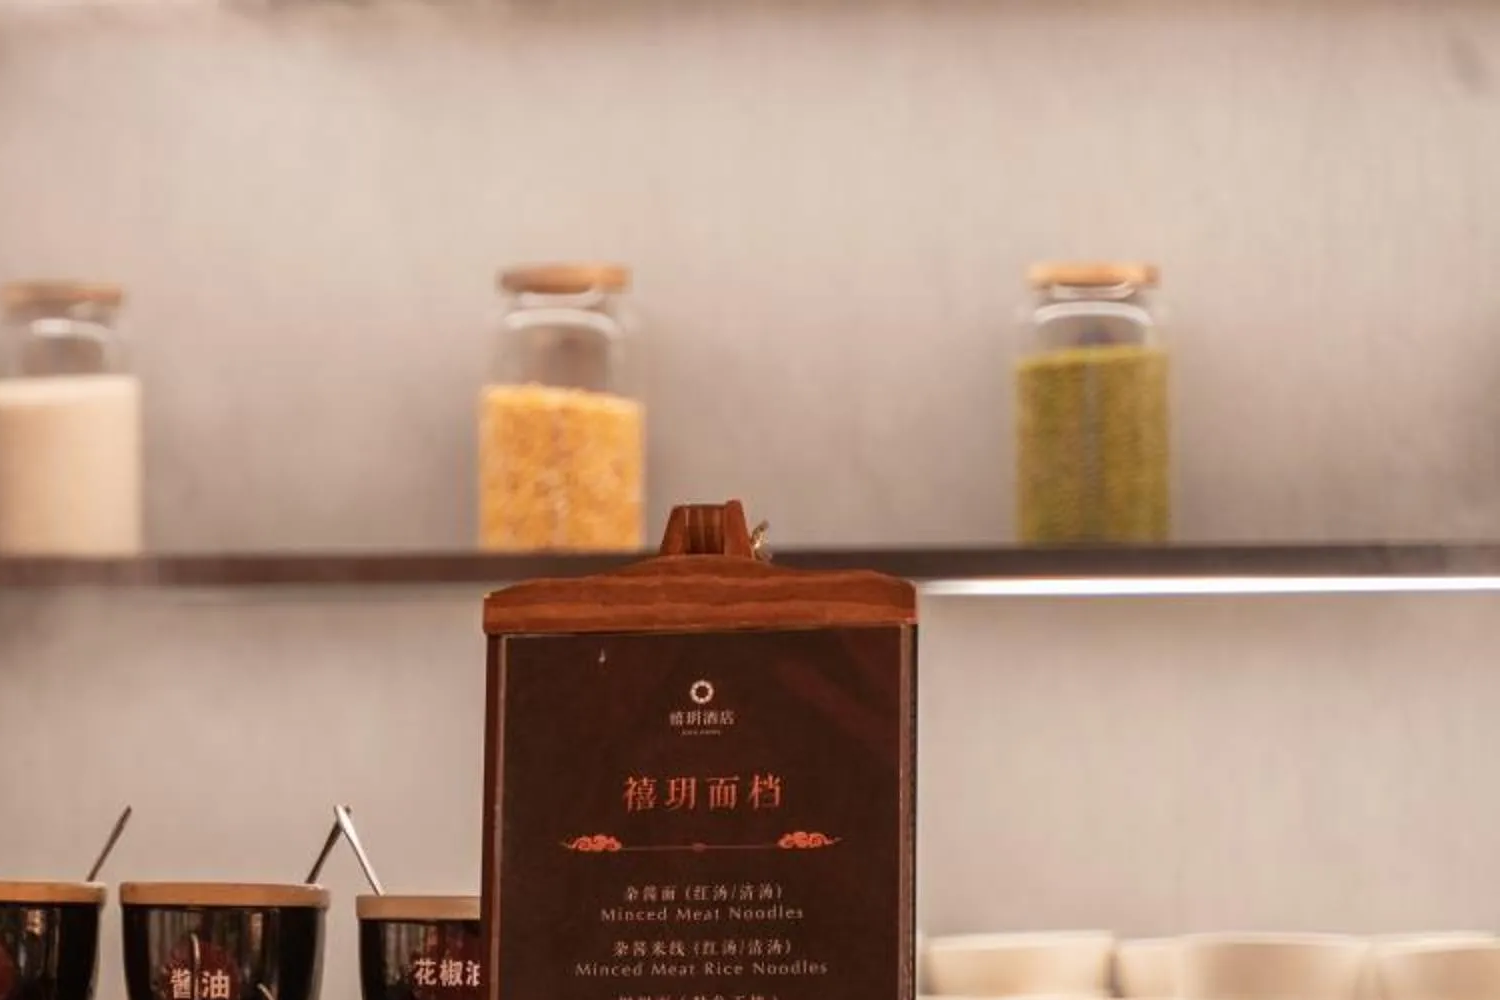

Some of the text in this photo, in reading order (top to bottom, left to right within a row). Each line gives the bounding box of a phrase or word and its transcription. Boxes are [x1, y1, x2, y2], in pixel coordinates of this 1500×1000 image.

[623, 772, 783, 811] 禧玥面档
[601, 905, 804, 922] Minced Meat Noodles
[575, 959, 829, 977] Minced Meat Rice Noodles
